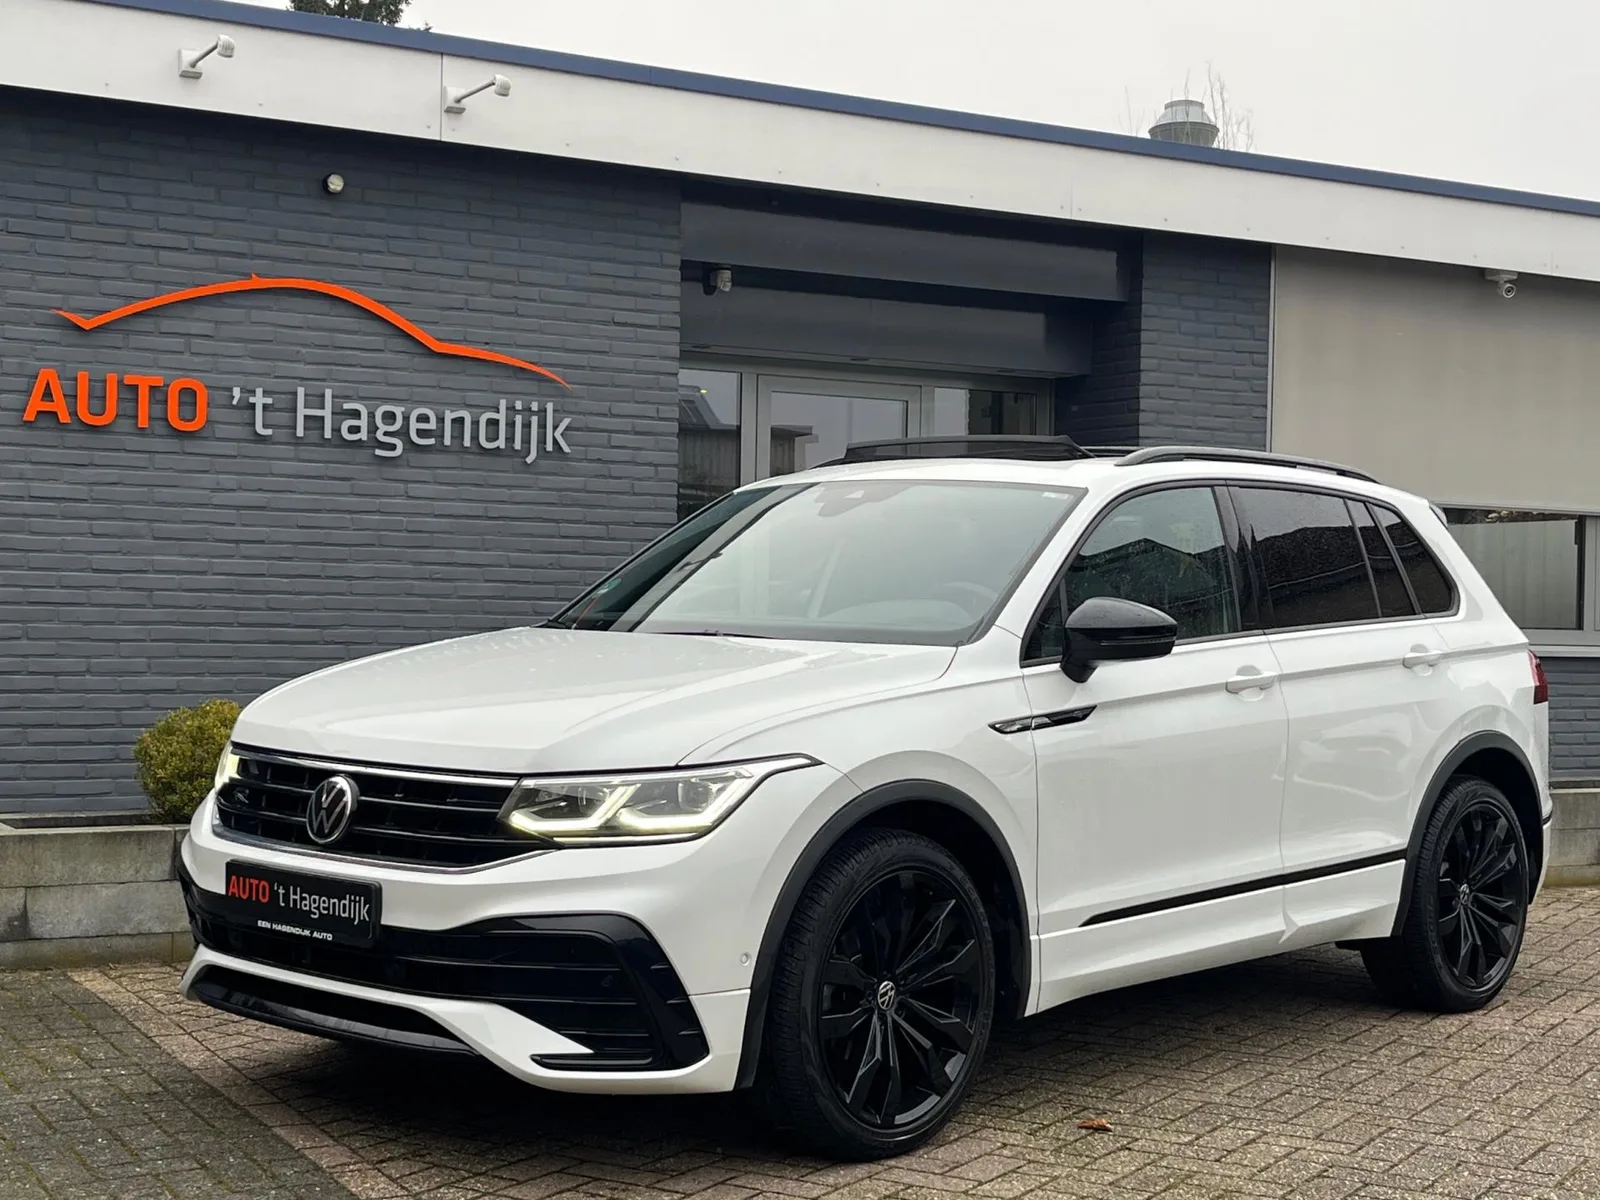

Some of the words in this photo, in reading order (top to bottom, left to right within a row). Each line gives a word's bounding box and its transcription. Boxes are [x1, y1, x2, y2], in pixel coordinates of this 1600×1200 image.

[23, 368, 209, 432] AUTO
[231, 386, 273, 437] 't
[296, 386, 573, 465] Hagendijk
[228, 875, 271, 904] AUTO
[290, 885, 370, 926] Hagendijk
[257, 919, 271, 929] EEN
[272, 923, 311, 937] HAGENDIJK
[312, 931, 333, 941] AUTO
